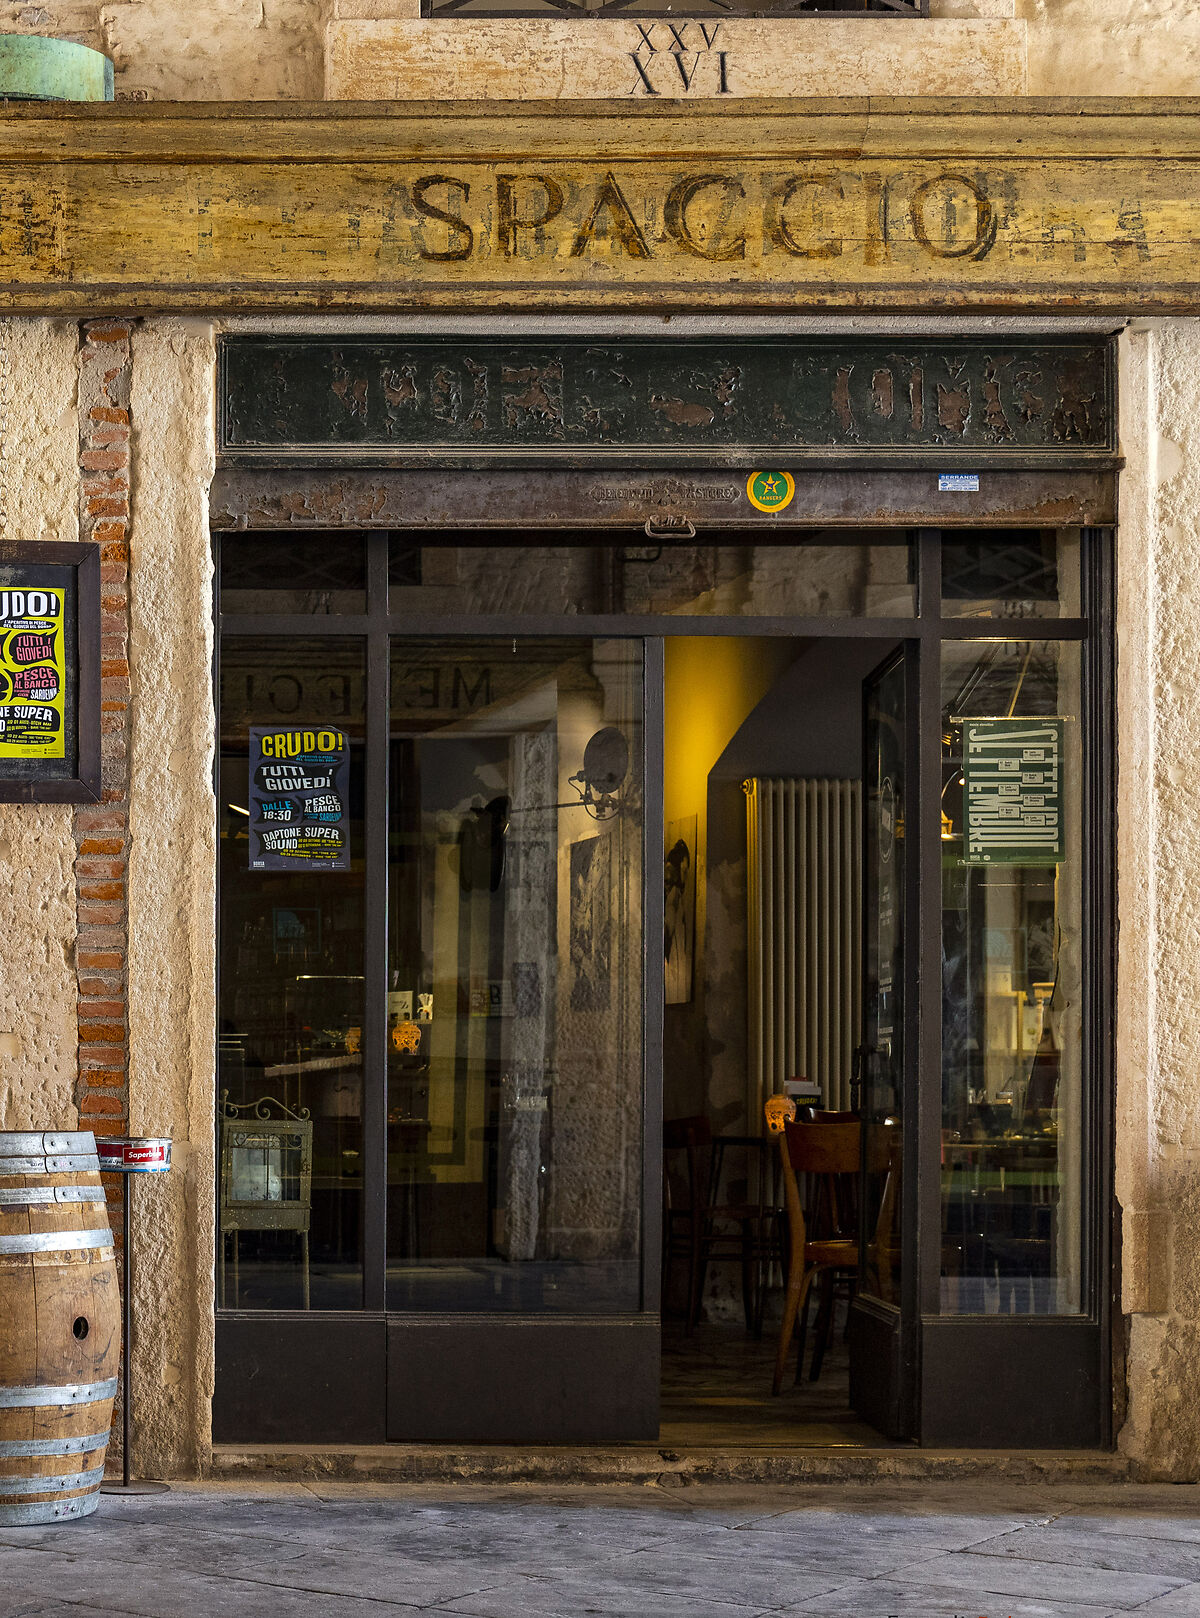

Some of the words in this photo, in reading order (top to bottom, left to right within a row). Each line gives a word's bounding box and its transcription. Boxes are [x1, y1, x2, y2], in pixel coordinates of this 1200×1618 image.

[636, 23, 721, 51] XXV
[626, 51, 732, 95] XVI
[409, 170, 1001, 263] SPACCIO
[17, 635, 43, 646] TUTTI
[15, 667, 56, 681] PESCE
[14, 681, 22, 689] AL
[24, 679, 57, 689] BANCO
[14, 706, 52, 721] SUPER
[261, 731, 343, 758] CRUDO!
[261, 765, 305, 776] TUTTI
[262, 801, 293, 811] DALLE
[305, 795, 341, 806] PESCE
[313, 805, 341, 813] BANCO
[263, 810, 291, 821] 18:30
[262, 827, 302, 842] DAPTONE
[304, 827, 339, 839] SUPER
[265, 838, 298, 850] SOUND
